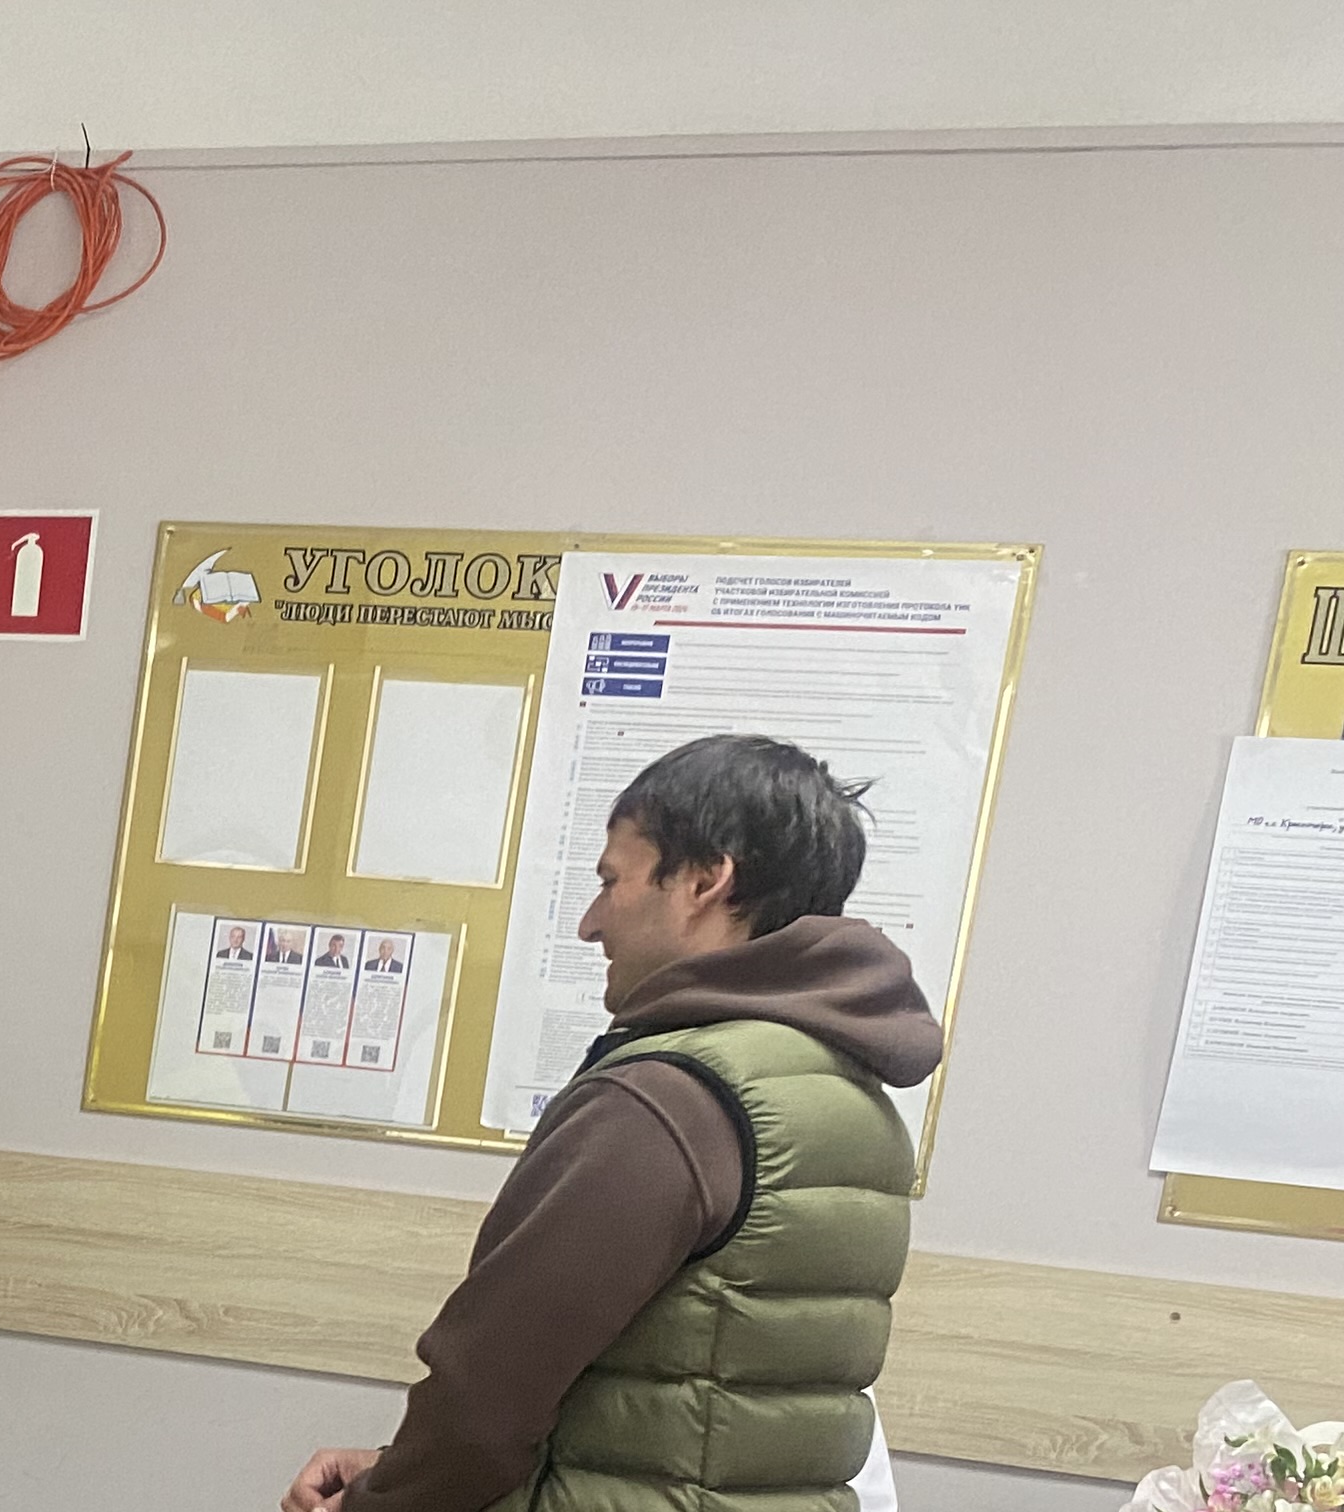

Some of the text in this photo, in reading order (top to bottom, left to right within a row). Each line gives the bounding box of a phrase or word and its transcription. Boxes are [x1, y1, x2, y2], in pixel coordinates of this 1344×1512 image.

[283, 547, 561, 601] УГОЛОК
[647, 574, 689, 583] ВЫБОРЫ
[641, 584, 700, 594] ПРЕЗИДЕНТА
[635, 594, 673, 603] РОССИИ
[357, 604, 495, 629] ПЕРЕСТАЮТ
